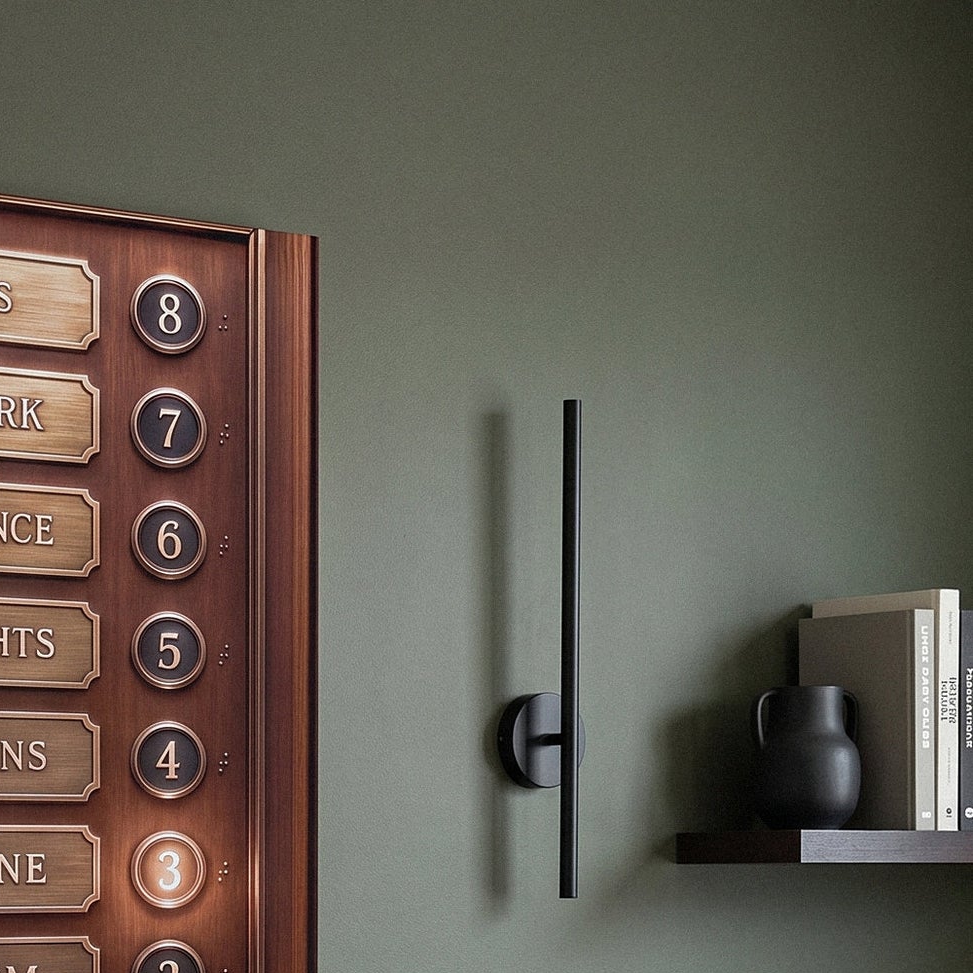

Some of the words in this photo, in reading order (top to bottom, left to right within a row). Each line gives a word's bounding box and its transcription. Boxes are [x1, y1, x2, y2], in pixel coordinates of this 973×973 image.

[158, 293, 183, 335] 8
[158, 408, 181, 448] 7
[157, 520, 182, 560] 6
[158, 633, 182, 671] 5
[155, 740, 181, 780] 4
[158, 850, 182, 891] 3
